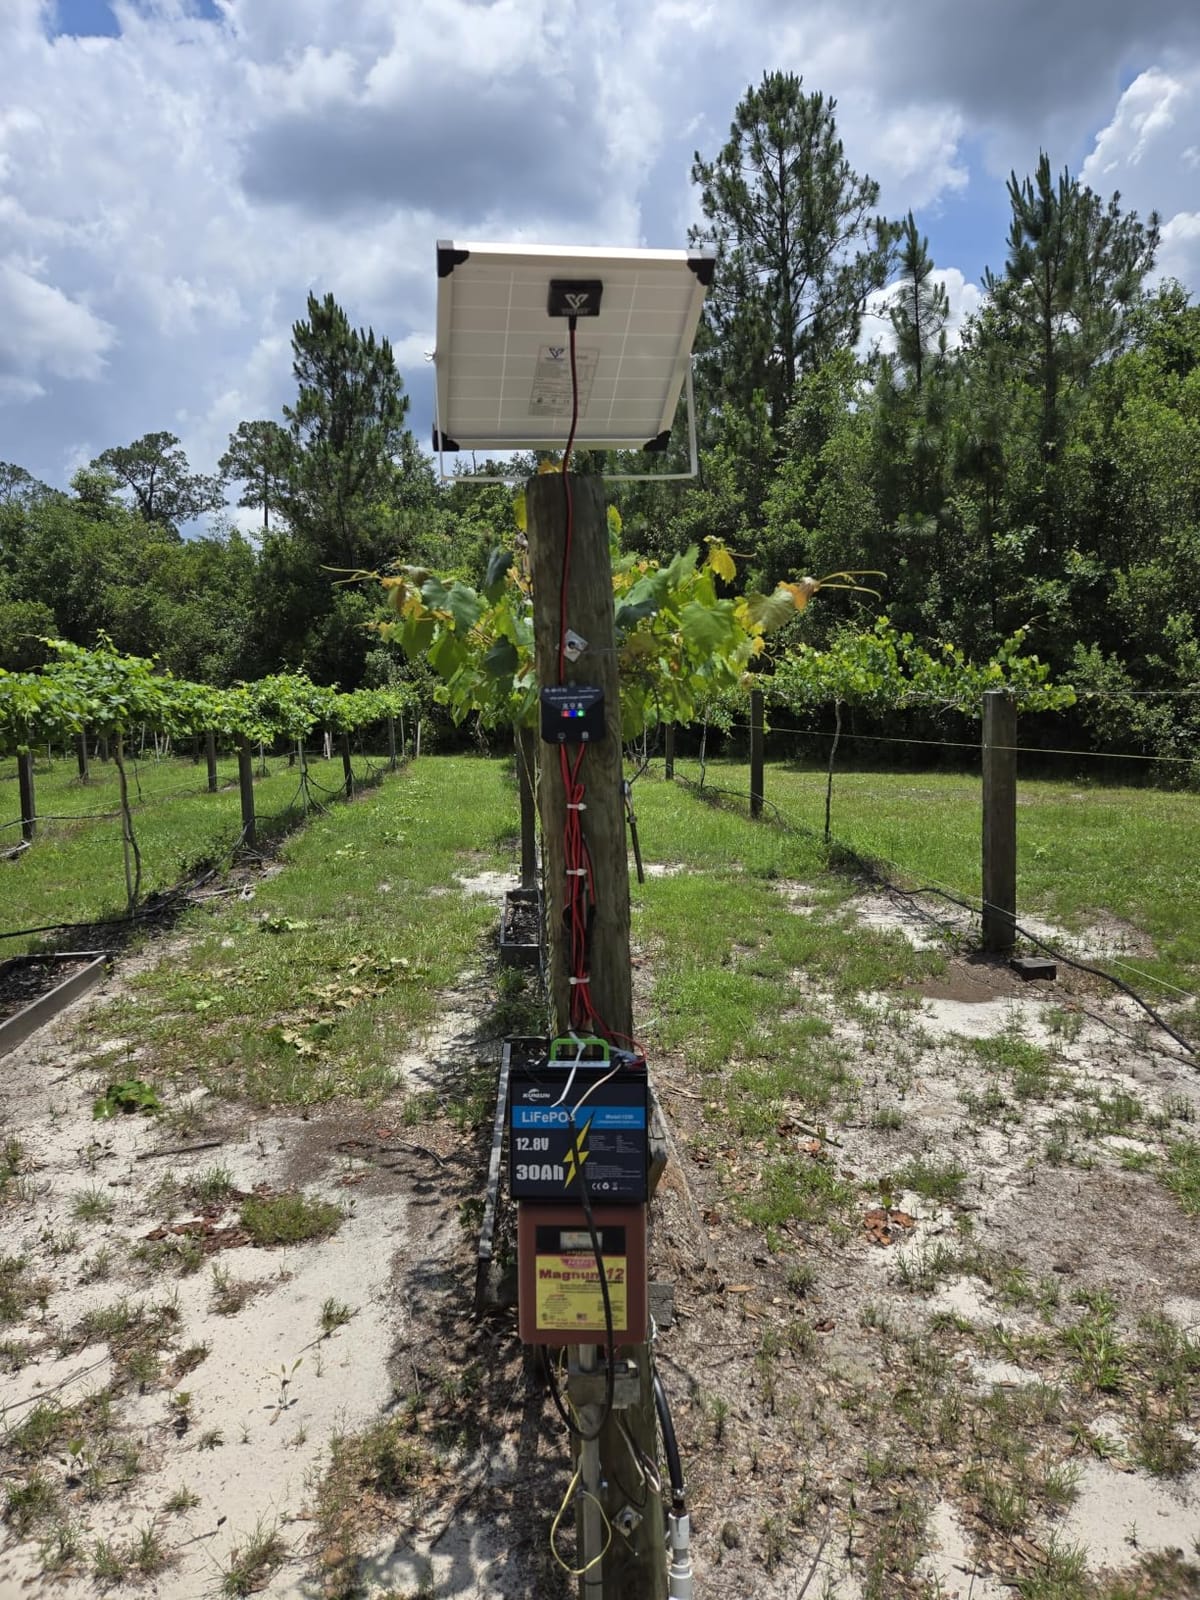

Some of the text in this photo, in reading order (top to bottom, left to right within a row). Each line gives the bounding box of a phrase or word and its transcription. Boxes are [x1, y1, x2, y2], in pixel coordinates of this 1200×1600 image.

[515, 1137, 549, 1151] 12.8V
[516, 1164, 564, 1180] 30Ah
[606, 1268, 625, 1280] 12
